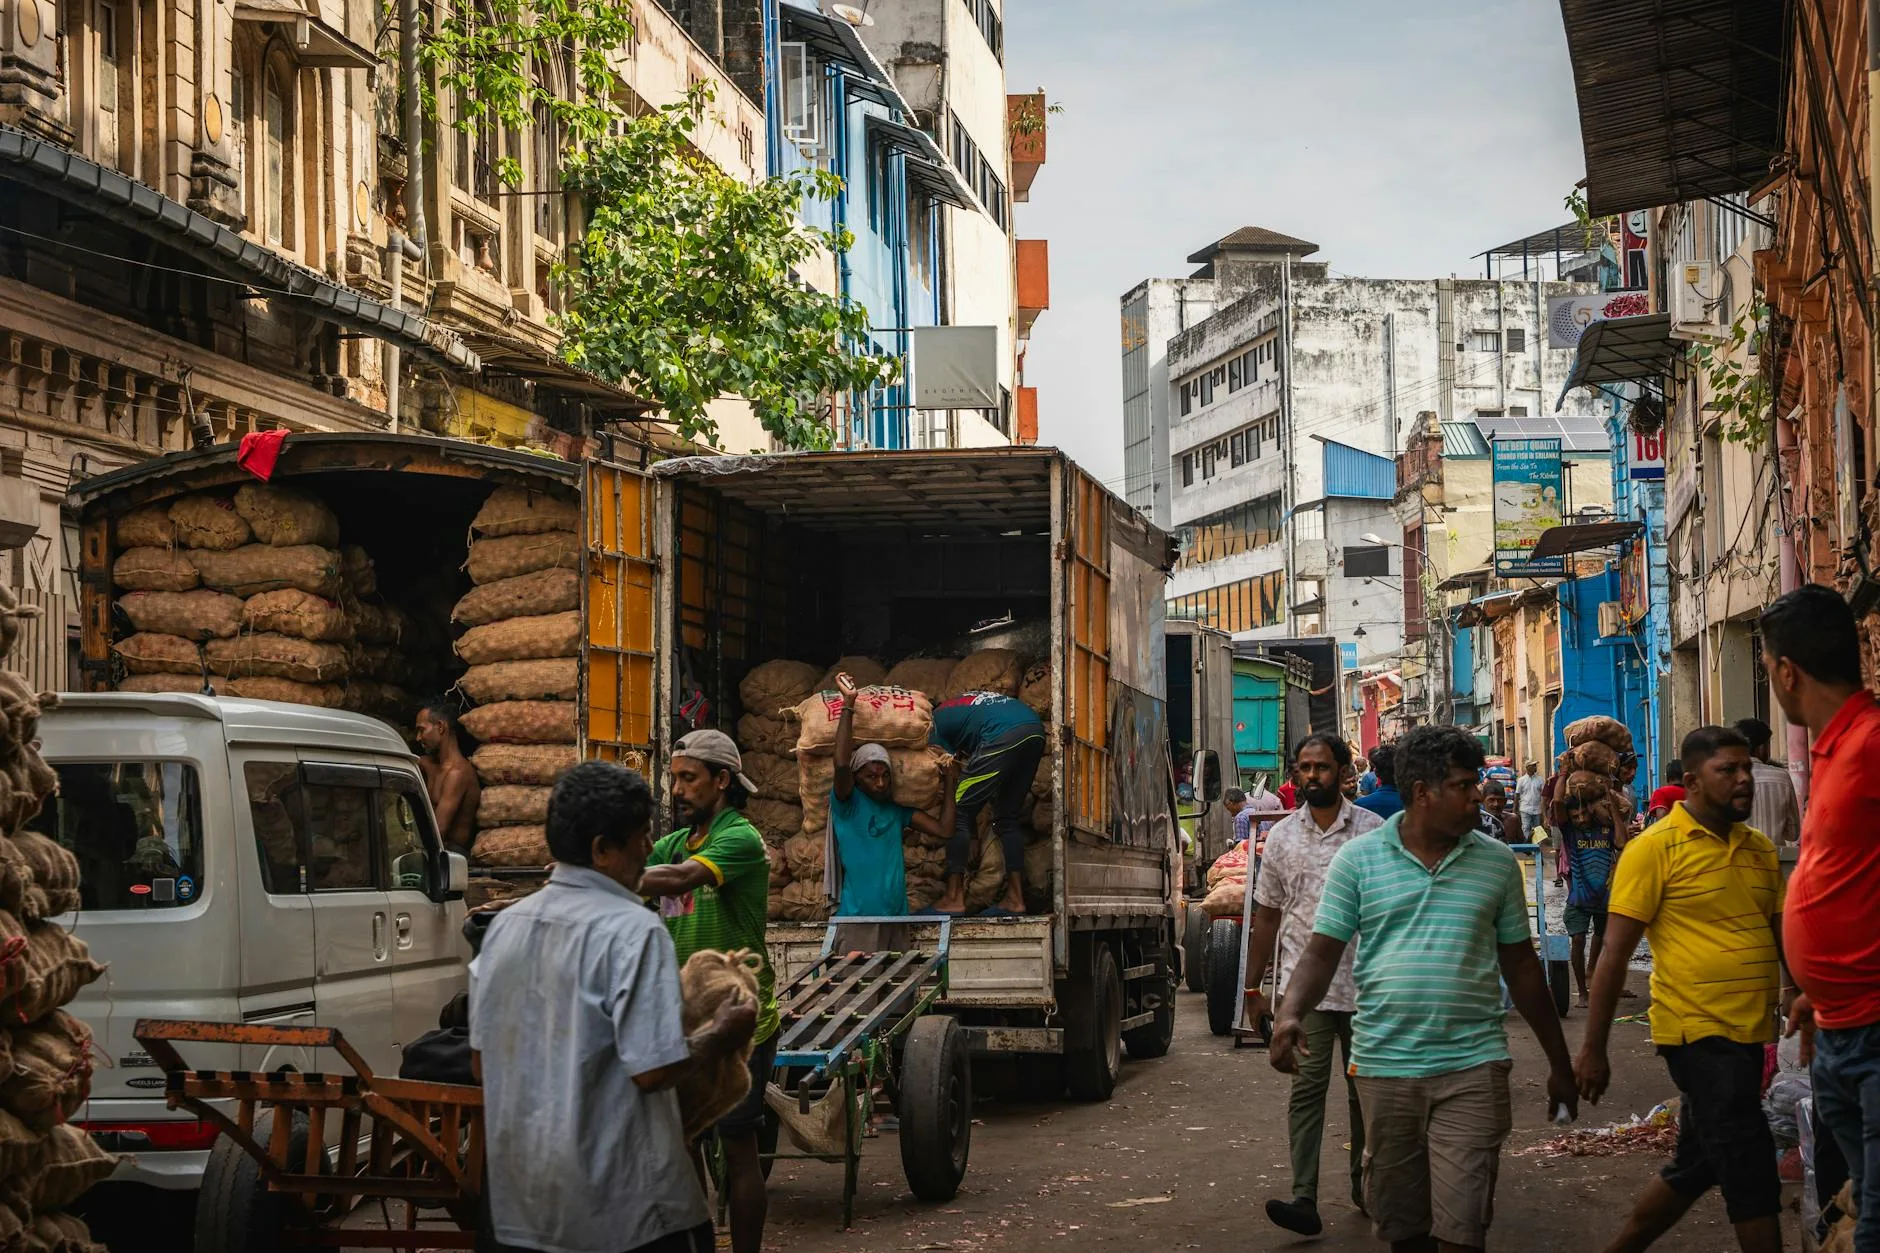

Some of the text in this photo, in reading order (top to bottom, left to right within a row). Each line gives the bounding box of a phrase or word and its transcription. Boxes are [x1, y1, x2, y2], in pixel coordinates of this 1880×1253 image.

[1496, 440, 1559, 451] THE BEST QUALITY
[1577, 839, 1588, 849] SRI
